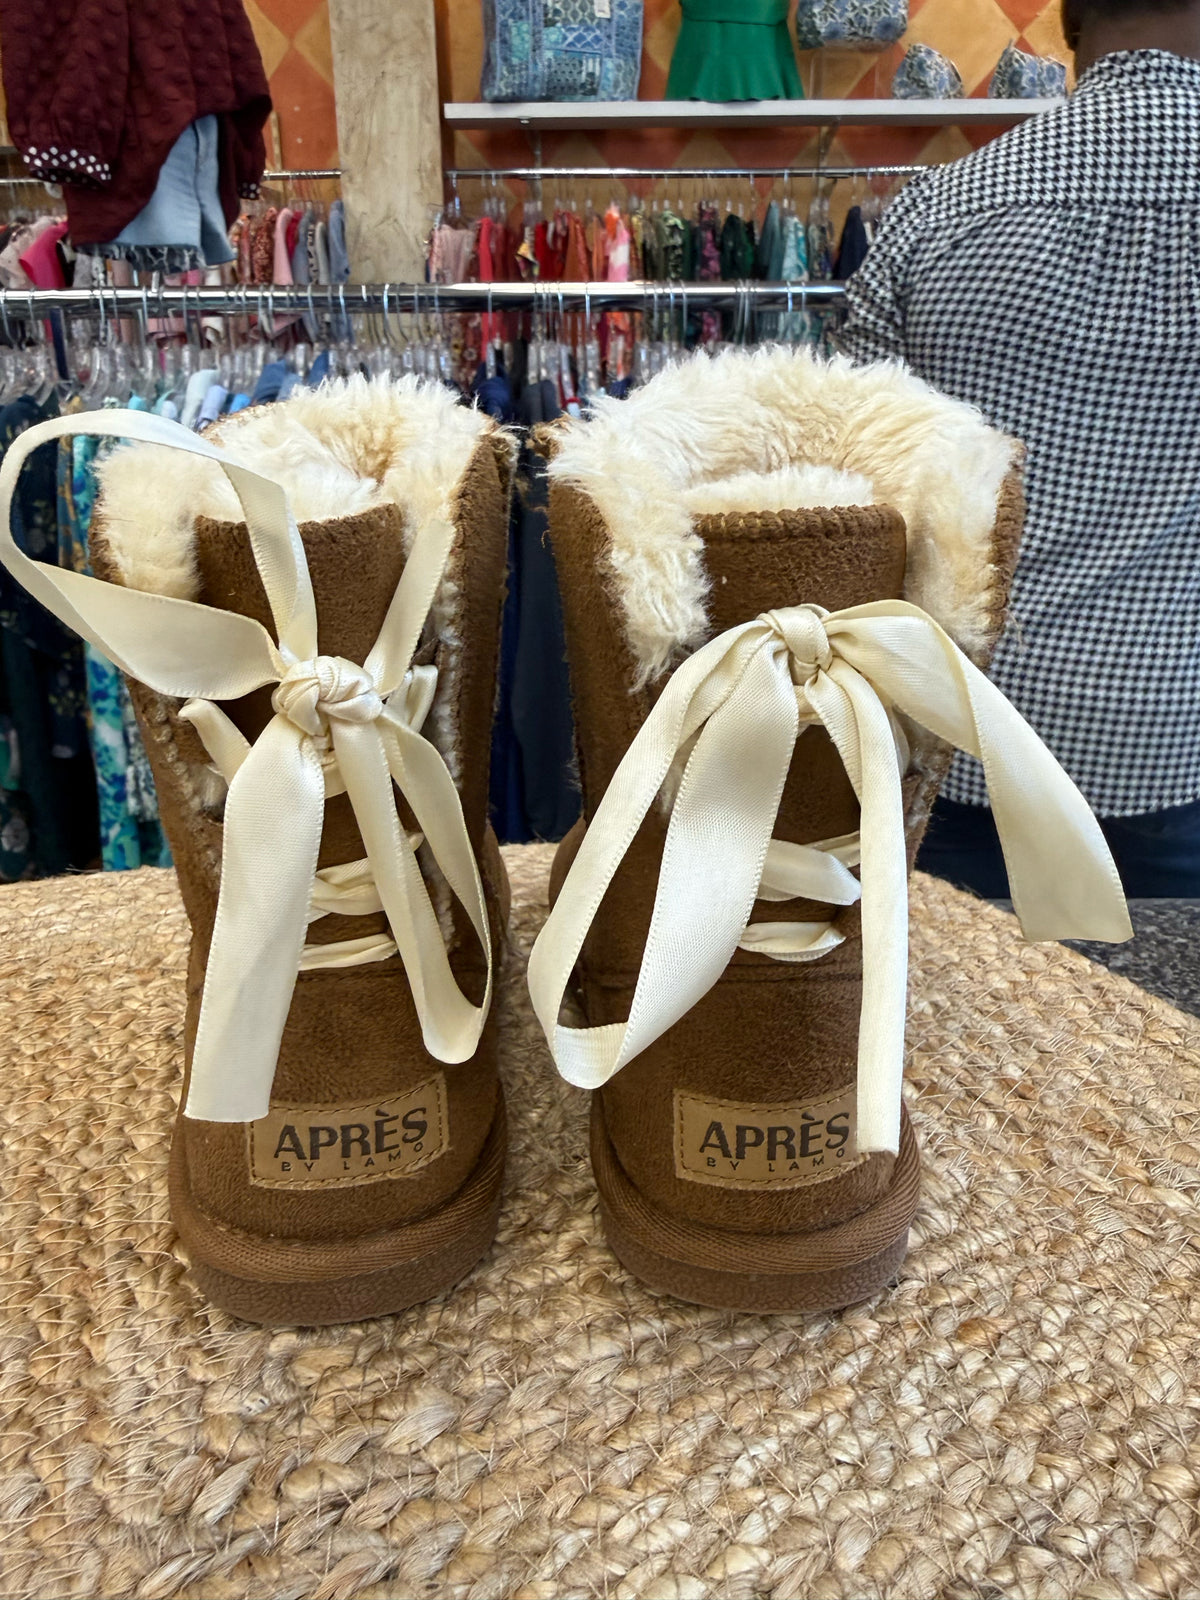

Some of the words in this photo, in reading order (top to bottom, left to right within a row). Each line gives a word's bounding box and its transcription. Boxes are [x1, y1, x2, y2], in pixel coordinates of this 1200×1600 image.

[273, 1107, 428, 1160] APRÈS
[699, 1111, 850, 1160] APRÈS
[281, 1161, 314, 1172] BY
[343, 1142, 424, 1171] LAMO
[706, 1156, 740, 1171] BY
[768, 1148, 845, 1172] LAMO
